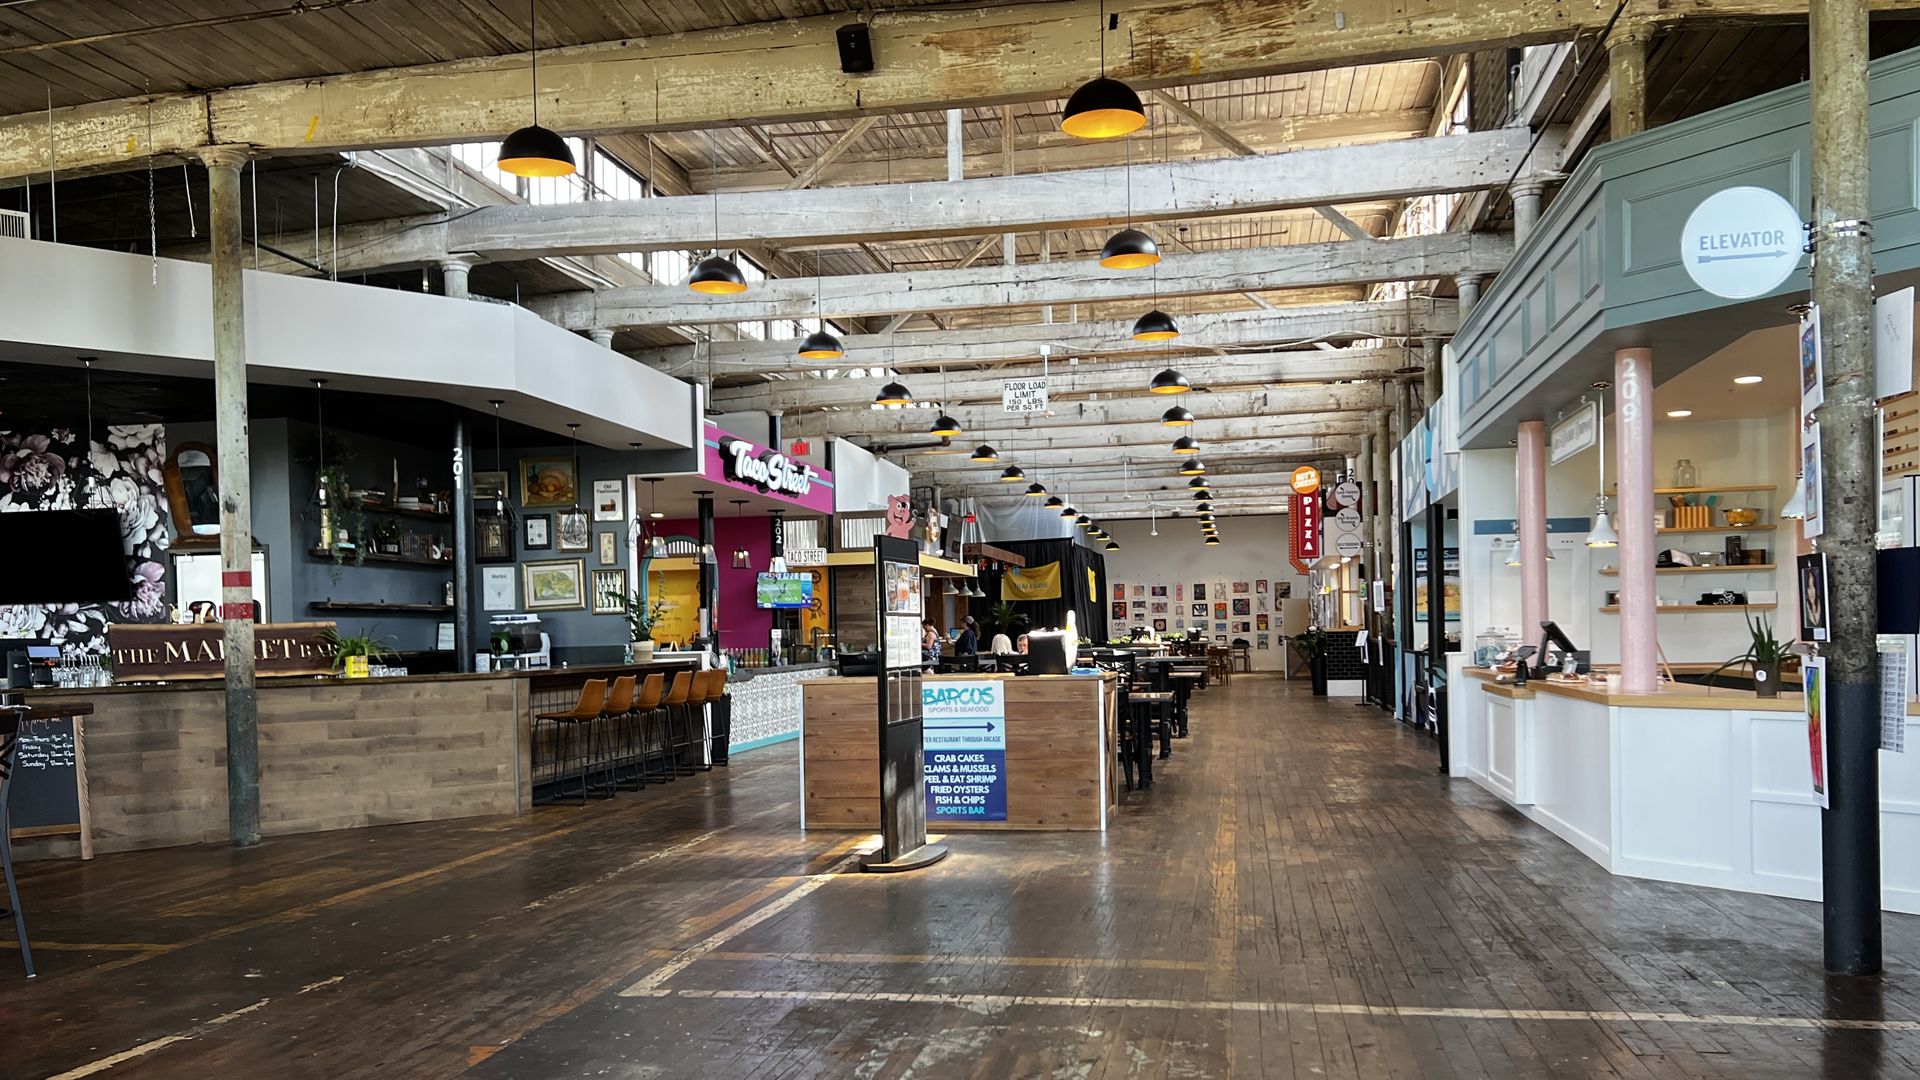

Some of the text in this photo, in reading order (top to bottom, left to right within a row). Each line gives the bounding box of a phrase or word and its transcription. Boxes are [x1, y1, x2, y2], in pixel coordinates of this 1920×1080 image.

[1699, 230, 1785, 251] ELEVATOR
[1004, 381, 1046, 390] FLOOR LOAD
[1622, 357, 1637, 423] 209
[453, 447, 463, 489] 201
[729, 440, 819, 495] Taco Street
[1303, 496, 1313, 551] PIZZA
[774, 518, 782, 544] 202
[787, 549, 824, 563] TACO STREET
[113, 648, 160, 664] THE
[164, 639, 296, 664] MAET
[923, 687, 995, 705] BARCOS
[18, 752, 49, 761] Saturday
[934, 754, 985, 762] CRAB CAKES
[22, 760, 46, 770] Sunday
[924, 765, 997, 773] CLAMS & MUSSELS
[924, 775, 997, 783] PEEL & EAT SHRIMP
[935, 796, 986, 804] FISH & CHIPS
[936, 806, 985, 814] SPORTS BAR
